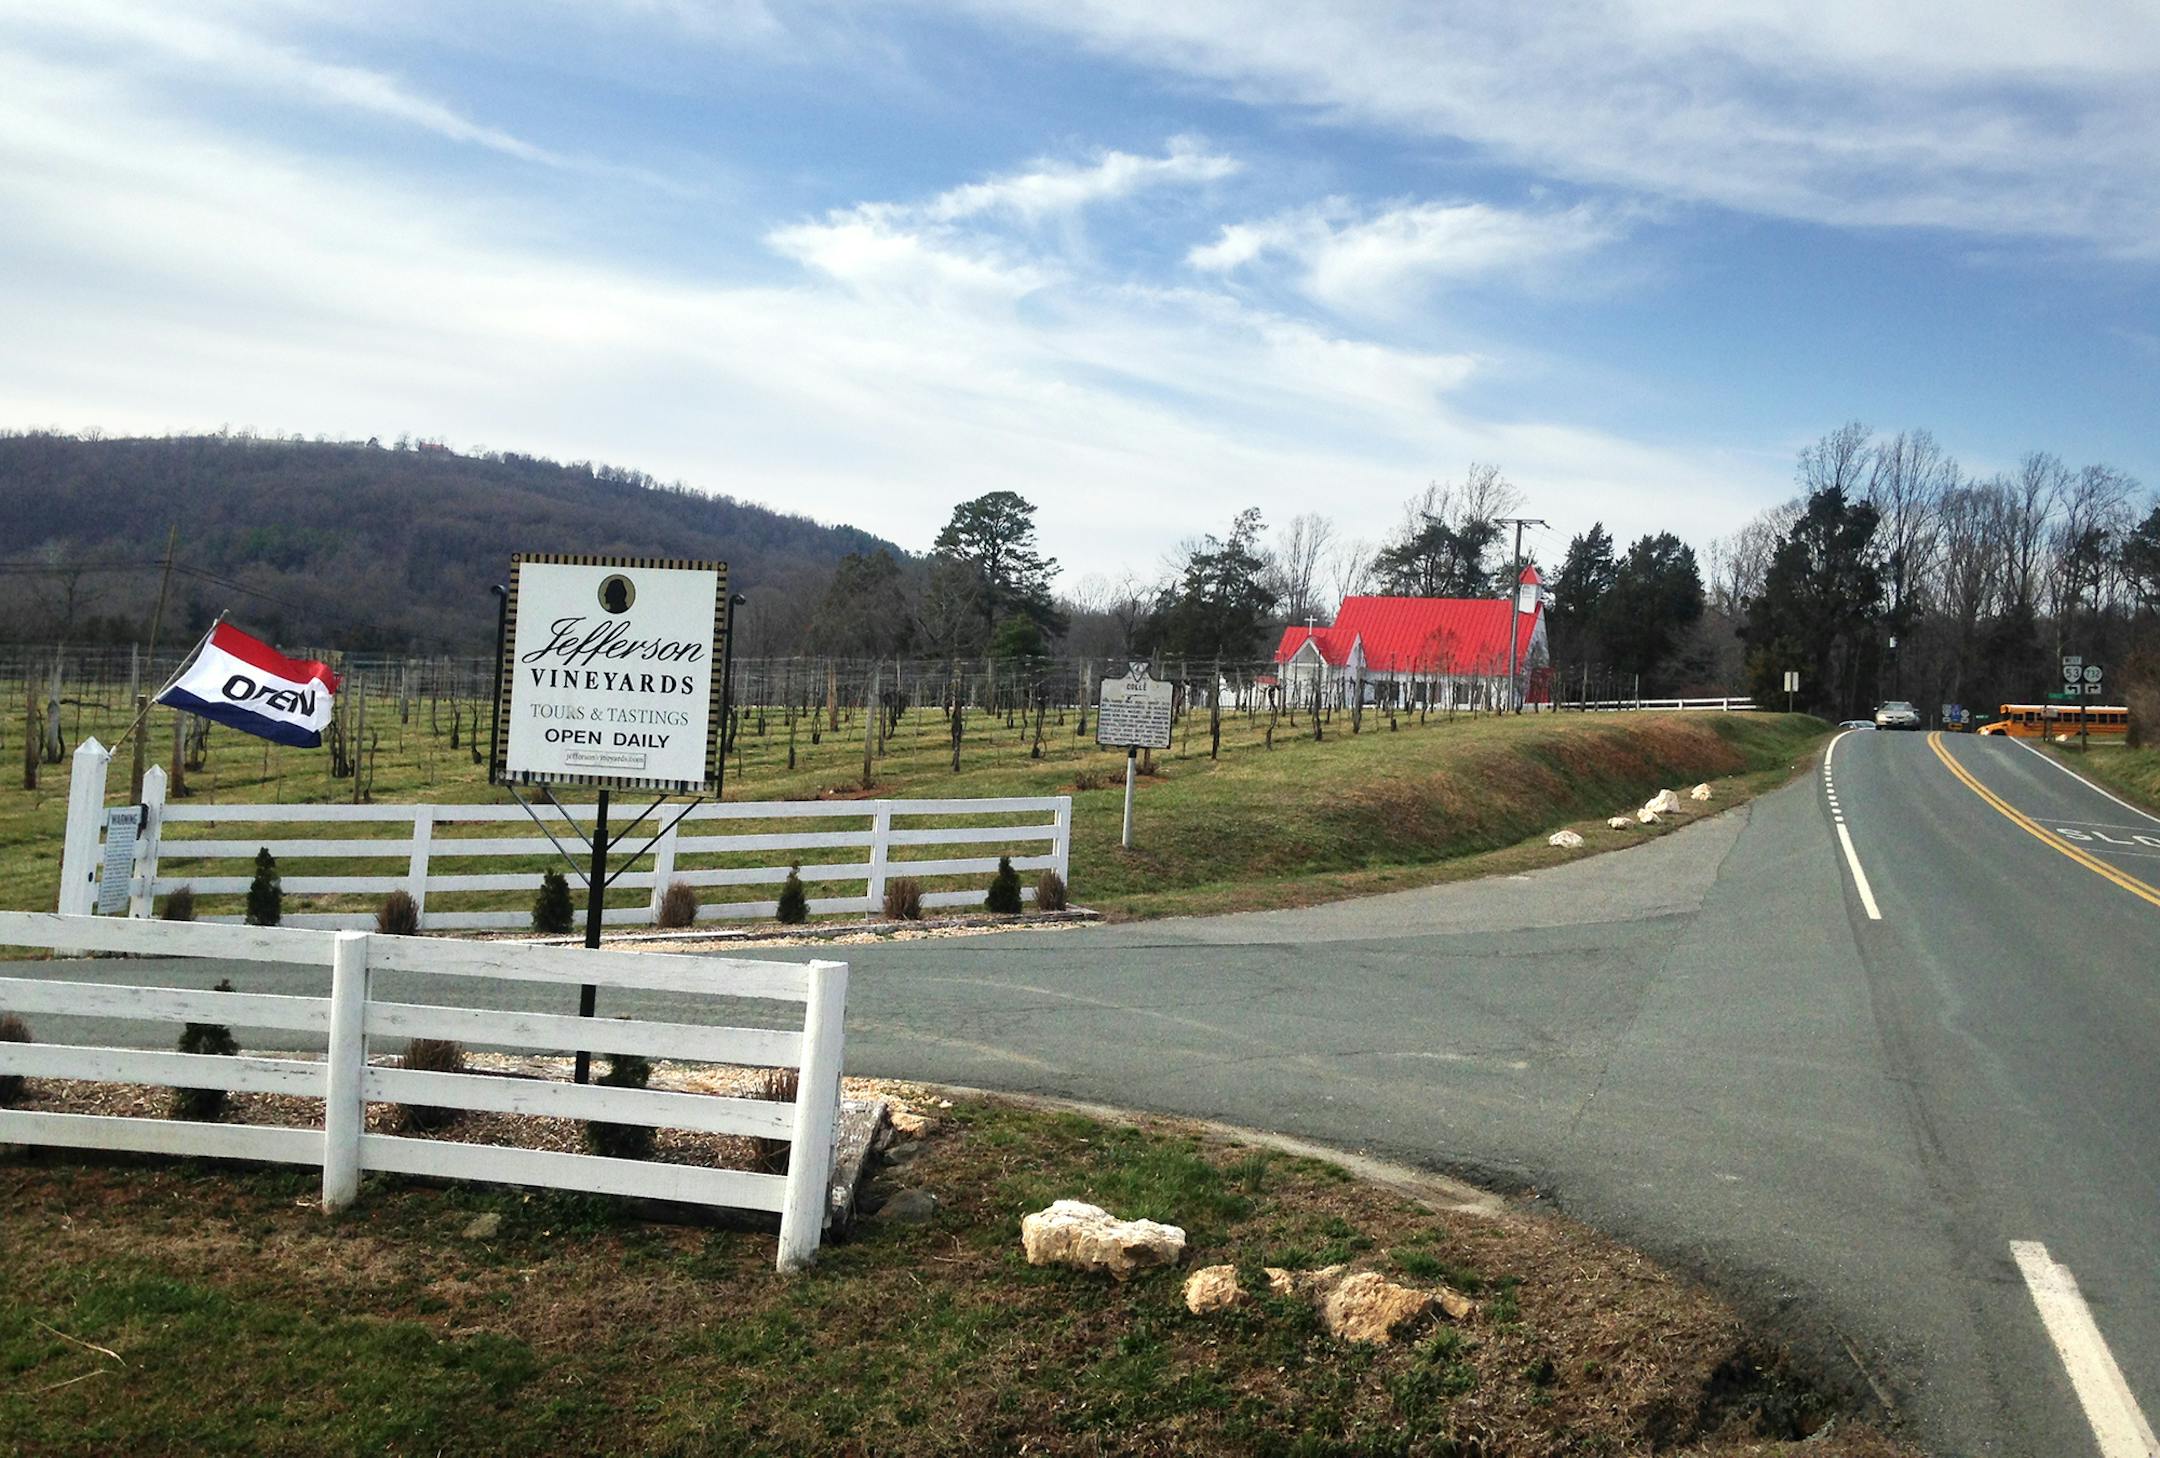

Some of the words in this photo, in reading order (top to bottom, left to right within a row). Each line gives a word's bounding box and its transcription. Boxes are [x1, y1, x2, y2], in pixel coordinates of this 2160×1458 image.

[521, 616, 705, 667] Jefferson
[530, 668, 694, 695] VINEYARDS
[2065, 668, 2080, 678] 53
[530, 703, 585, 720] TOURS
[590, 707, 603, 721] &
[607, 707, 689, 726] TASTINGS
[544, 728, 602, 745] OPEN
[613, 732, 670, 749] DAILY
